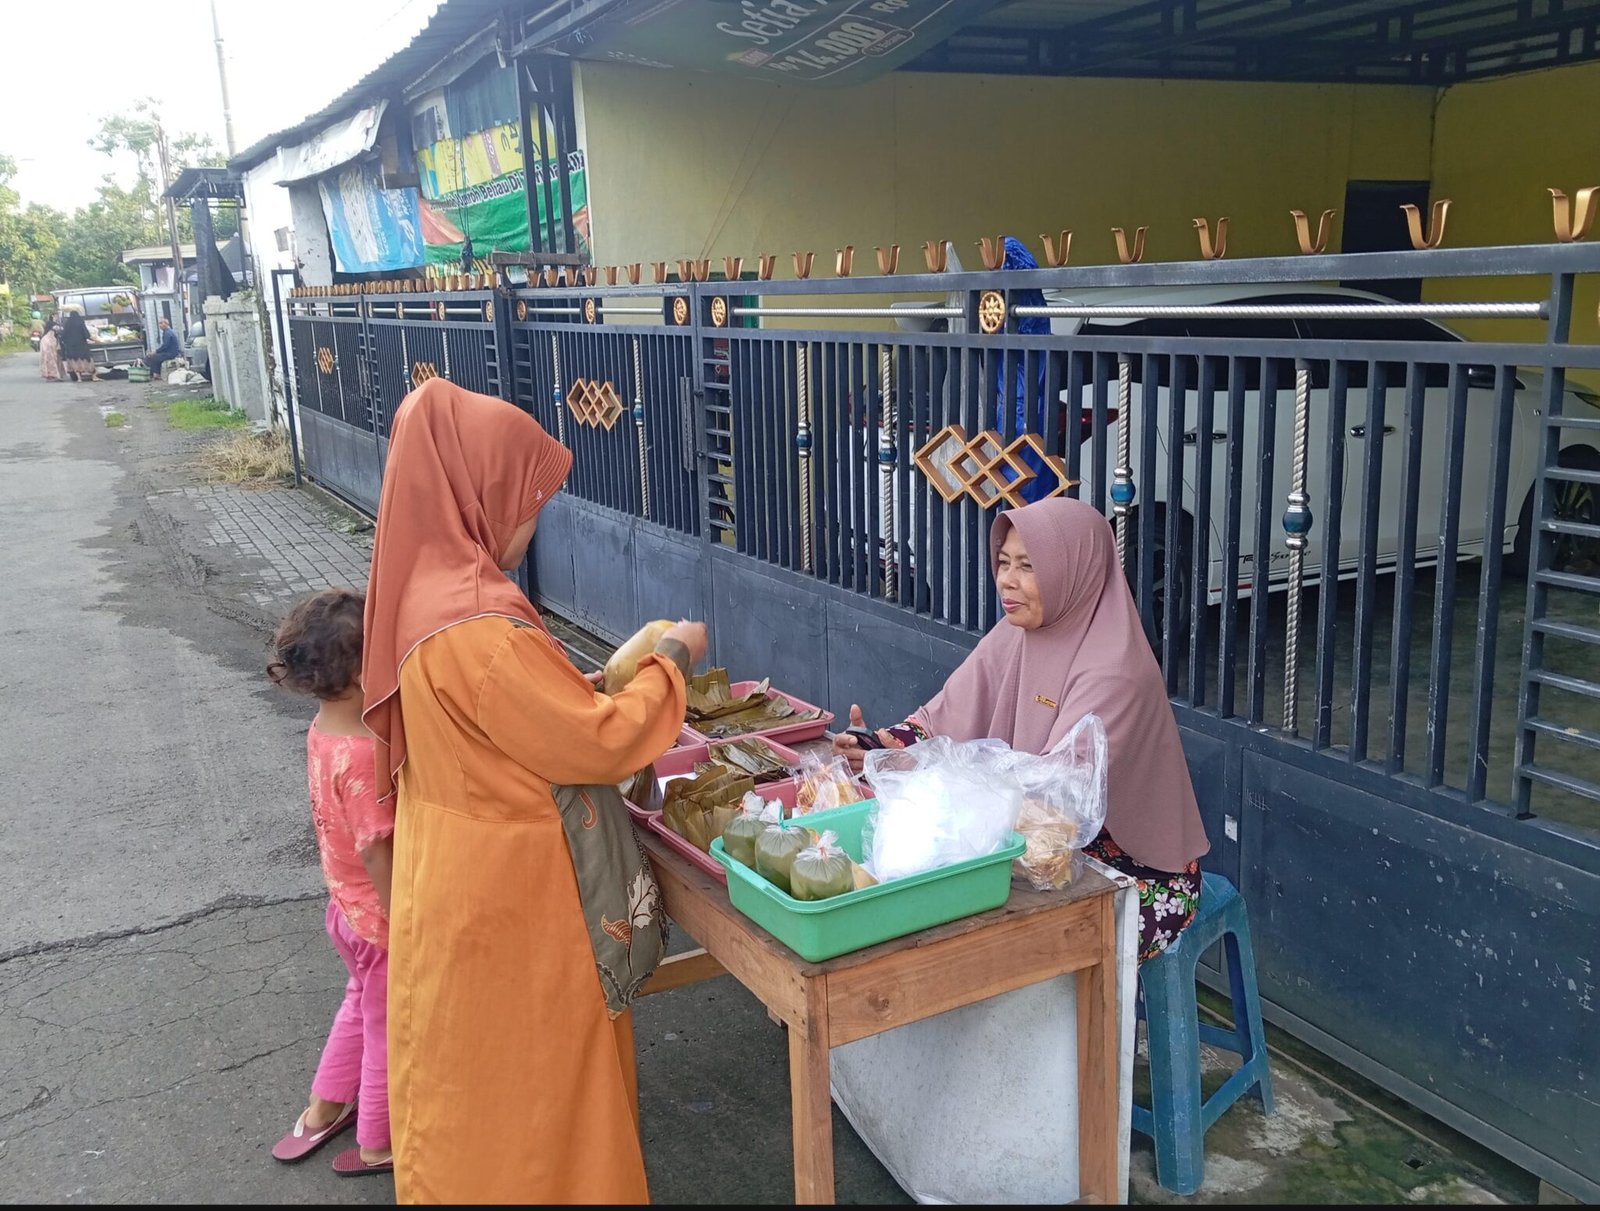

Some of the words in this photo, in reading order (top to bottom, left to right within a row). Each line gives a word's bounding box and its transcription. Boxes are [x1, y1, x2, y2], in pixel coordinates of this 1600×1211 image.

[716, 0, 817, 45] Setia
[480, 180, 509, 200] Beliau
[508, 173, 522, 190] Di
